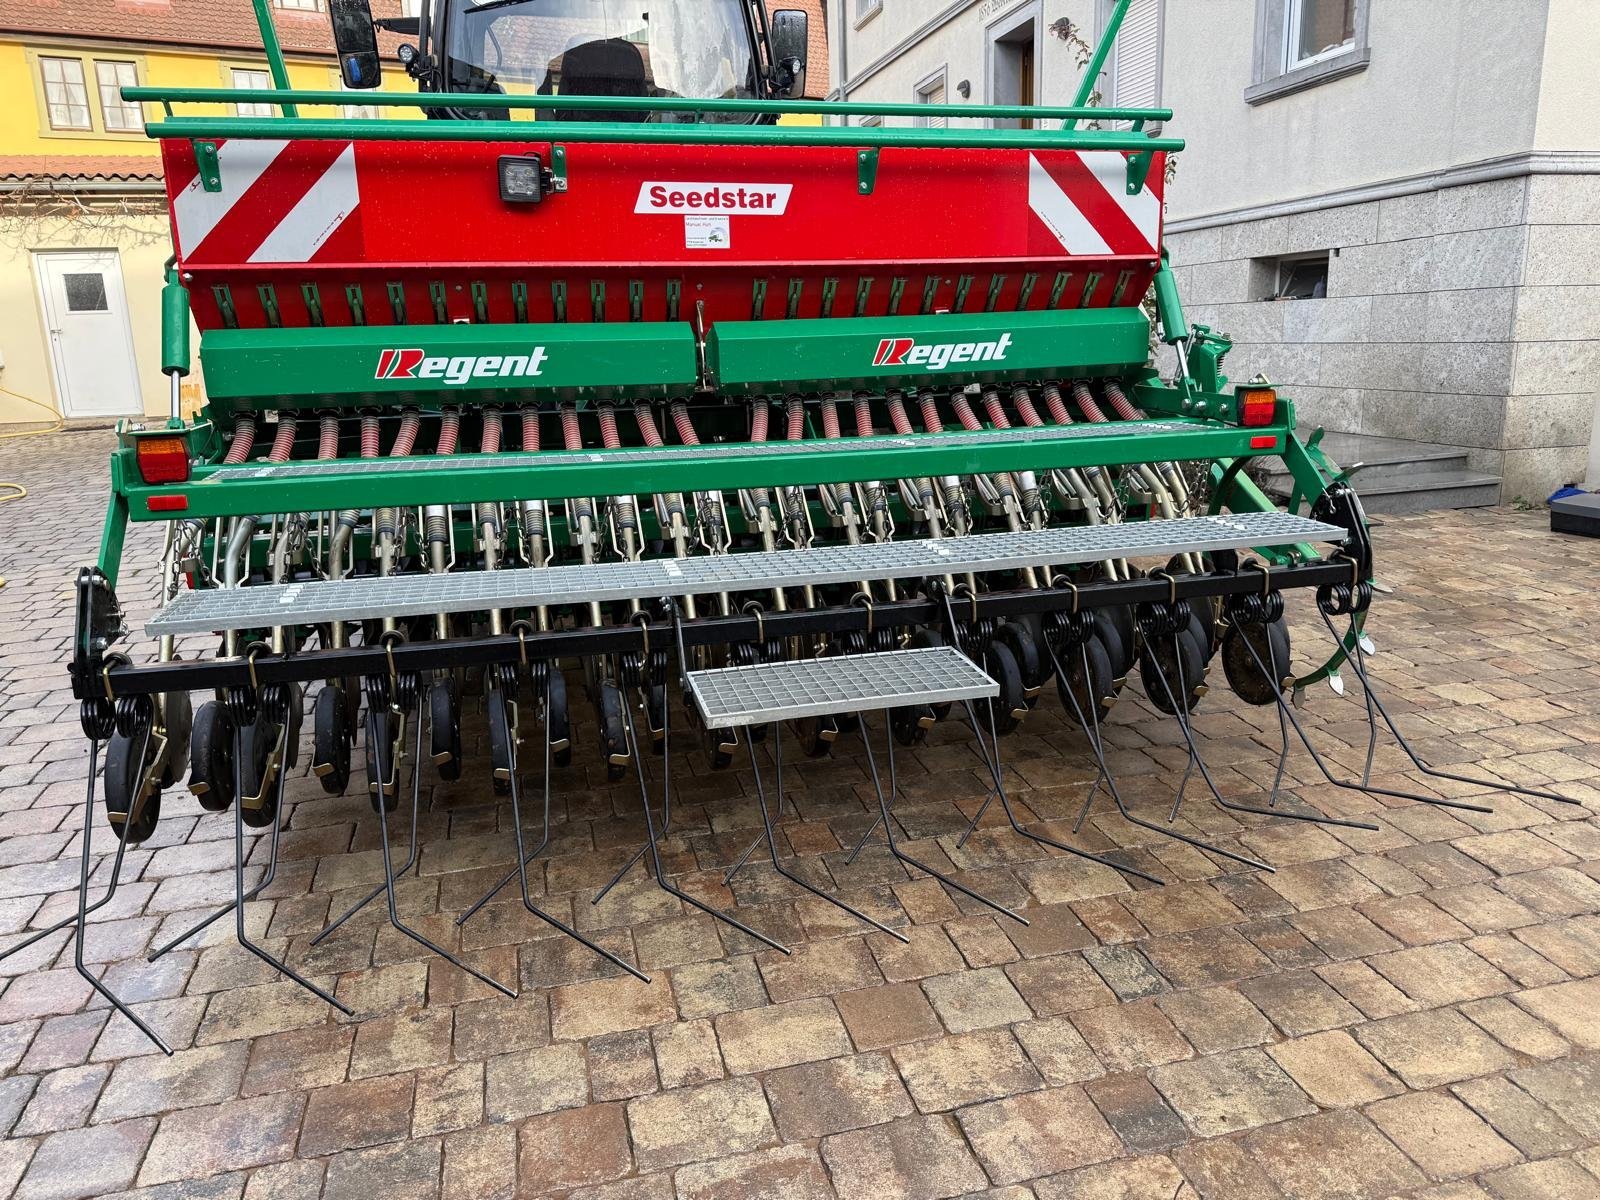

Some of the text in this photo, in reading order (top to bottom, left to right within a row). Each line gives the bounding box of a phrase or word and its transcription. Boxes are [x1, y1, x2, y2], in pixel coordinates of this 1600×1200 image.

[650, 185, 777, 209] Seedstar
[374, 346, 549, 385] Regent
[872, 332, 1013, 370] Regent
